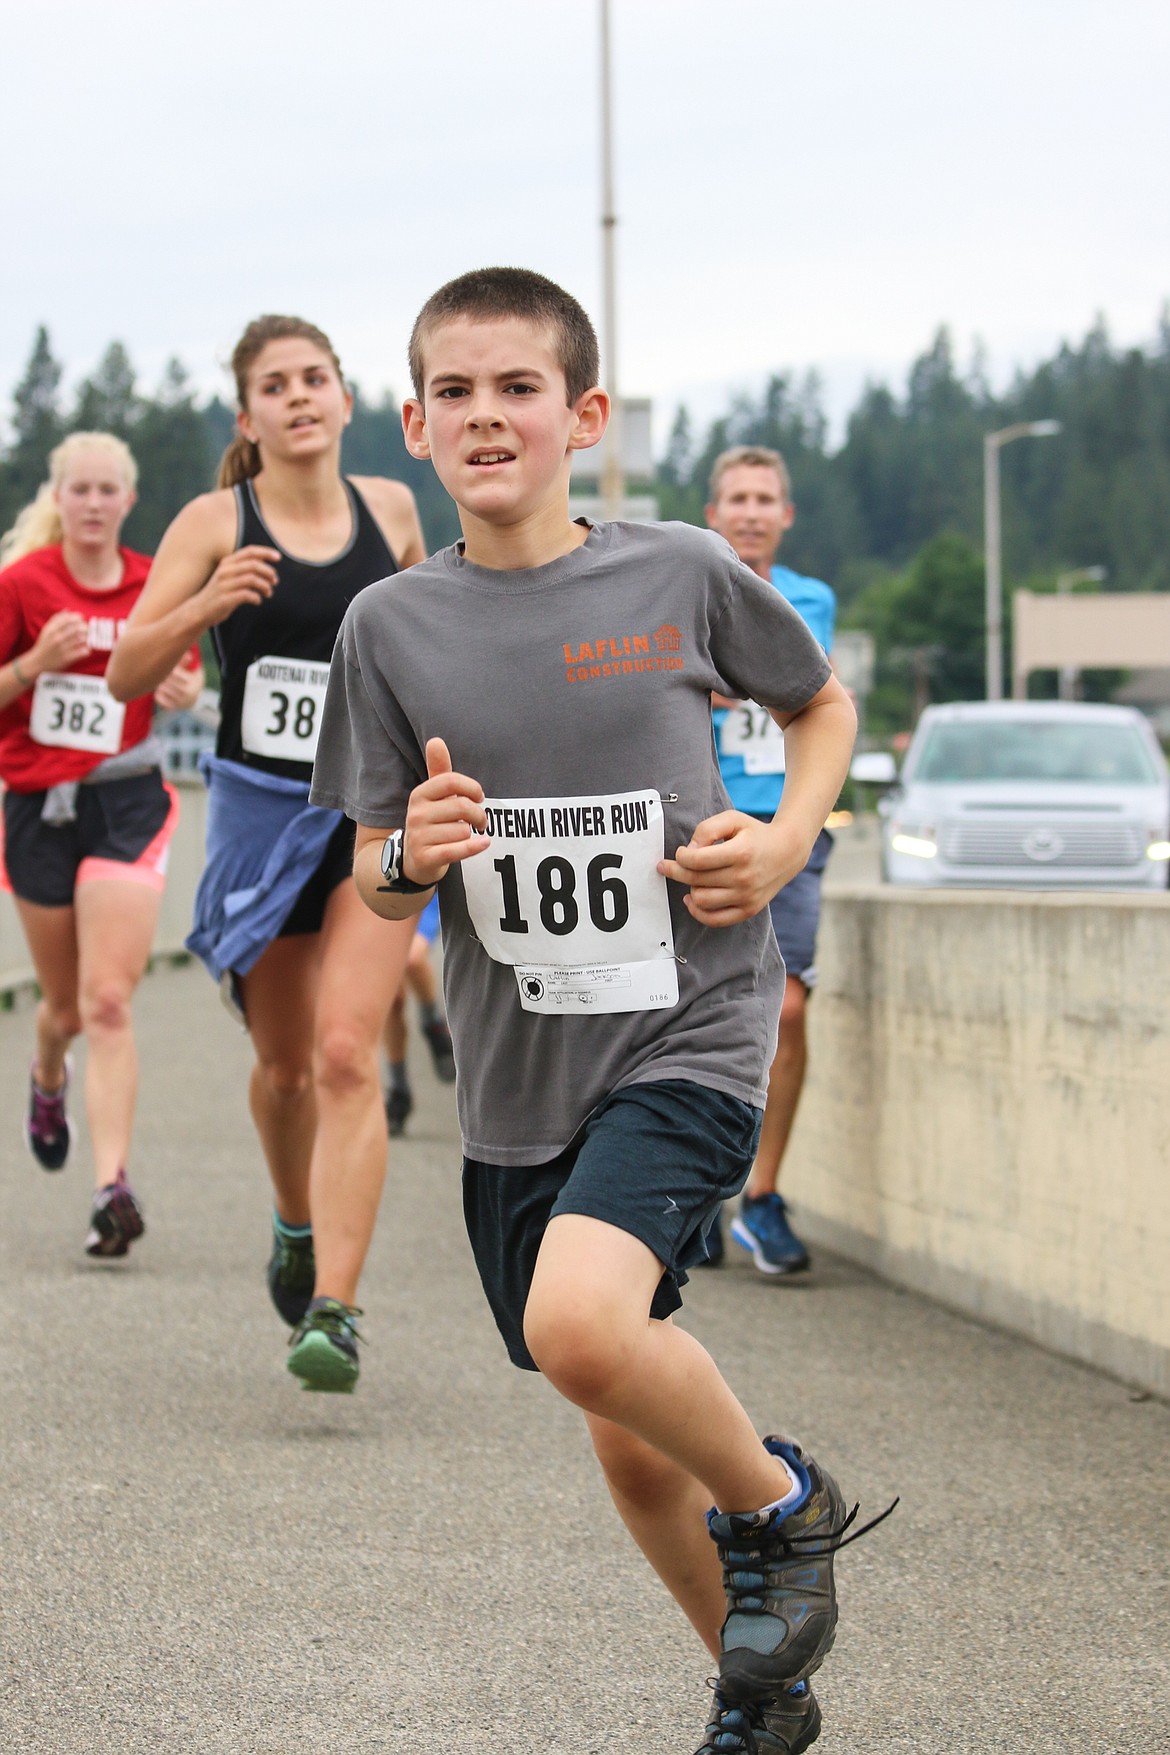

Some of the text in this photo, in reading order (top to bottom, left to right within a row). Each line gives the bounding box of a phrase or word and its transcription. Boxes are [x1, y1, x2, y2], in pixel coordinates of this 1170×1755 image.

[563, 634, 649, 664] LAFLIN
[566, 656, 684, 683] CONSTRUCTION
[49, 697, 105, 736] 382
[266, 691, 316, 739] 38
[739, 706, 784, 740] 37
[470, 801, 648, 838] OTENAI RIVER RUN
[493, 853, 629, 936] 186
[649, 993, 669, 1001] 0186
